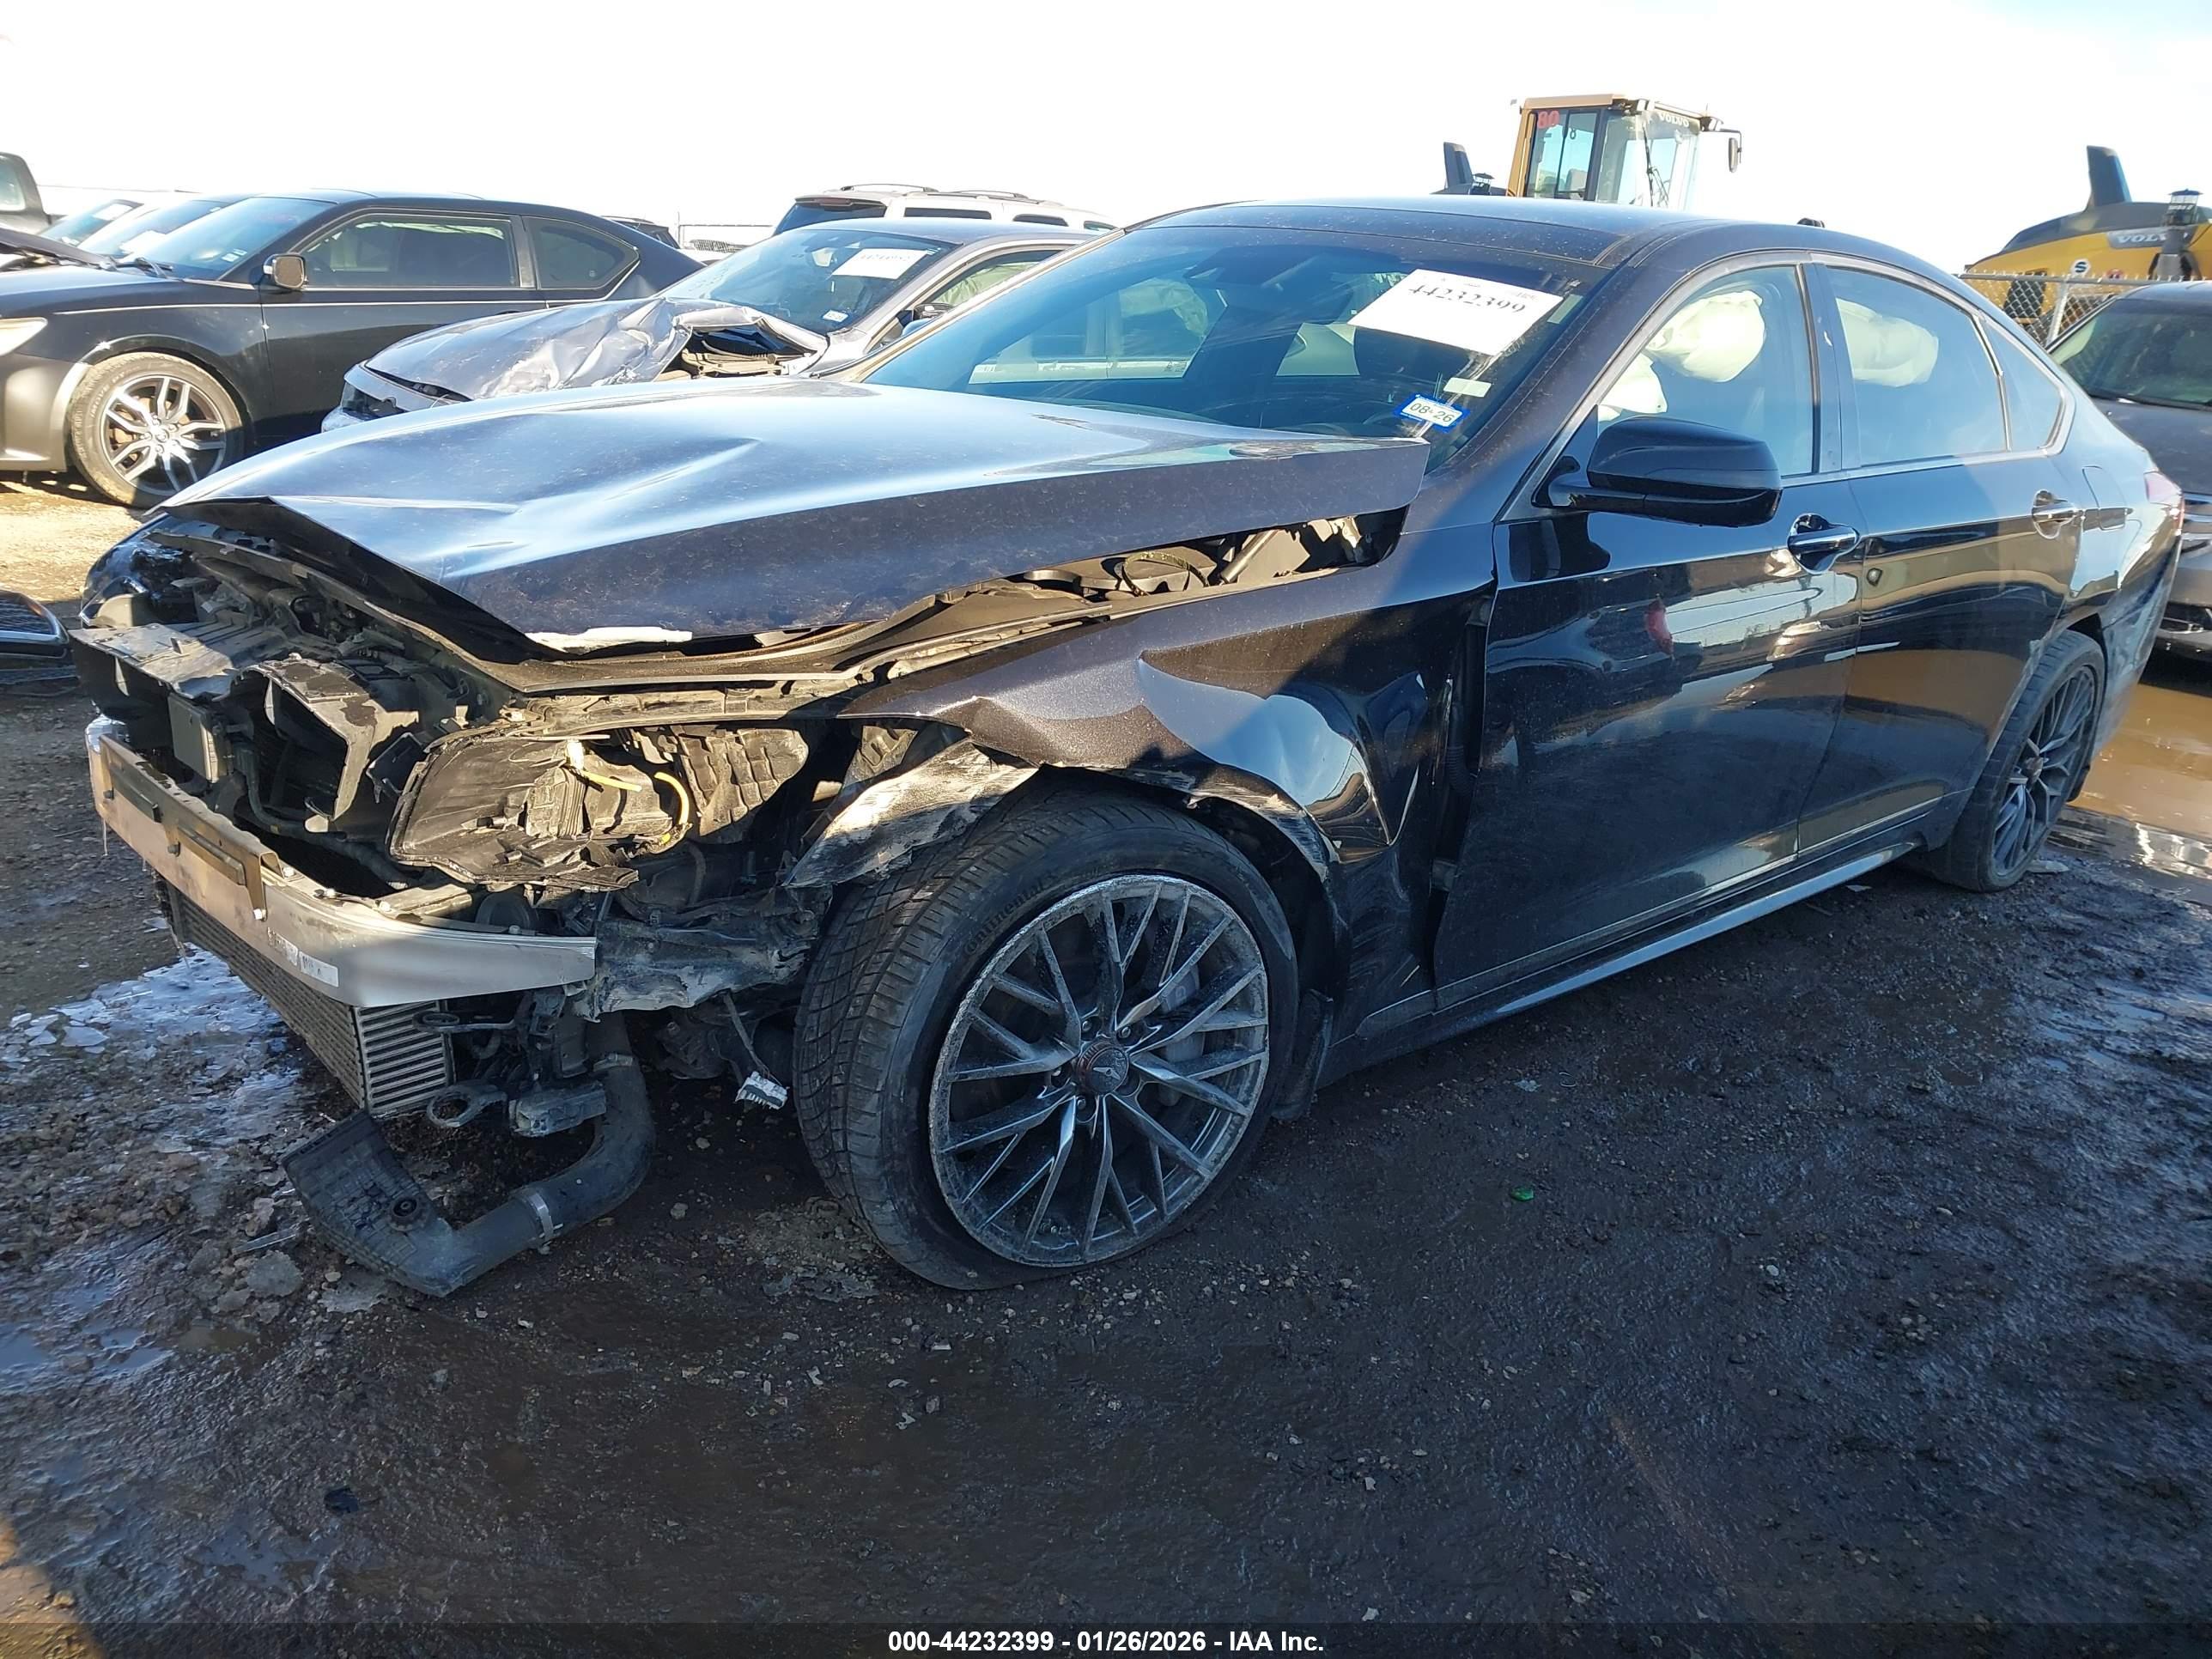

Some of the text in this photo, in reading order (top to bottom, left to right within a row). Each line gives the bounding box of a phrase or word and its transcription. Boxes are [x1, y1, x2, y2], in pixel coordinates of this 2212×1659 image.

[1658, 112, 1690, 128] VOLVO
[1408, 284, 1526, 313] 44232399
[962, 876, 1045, 957] Continental
